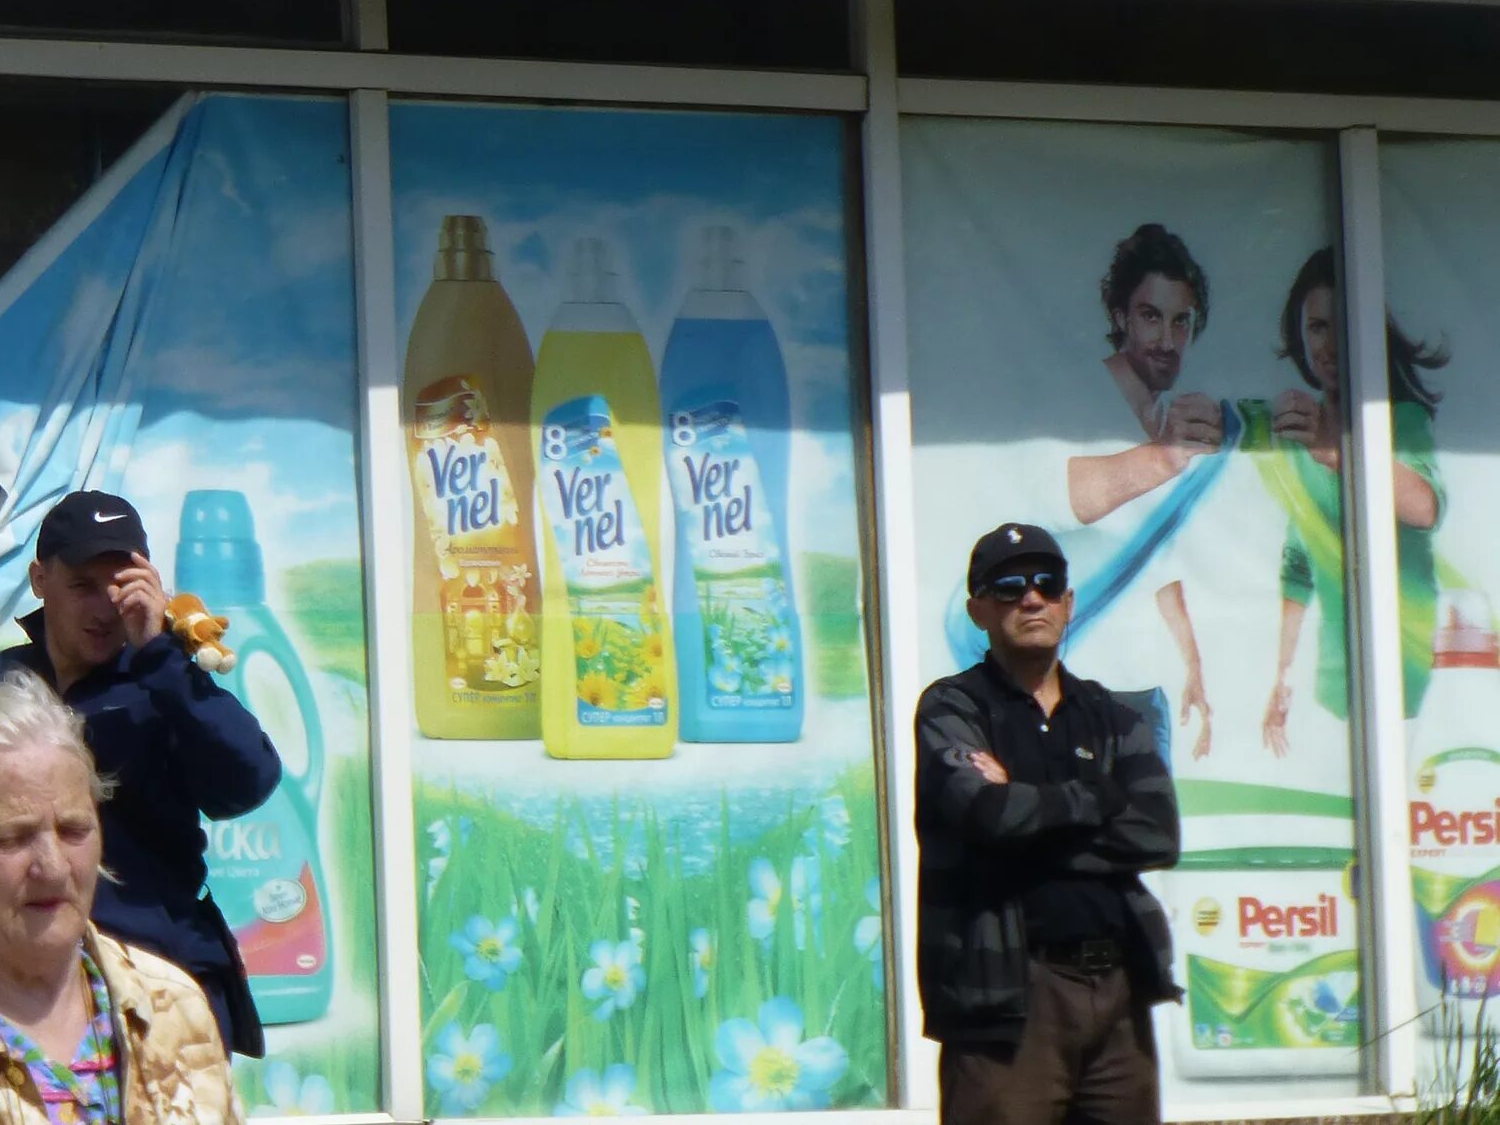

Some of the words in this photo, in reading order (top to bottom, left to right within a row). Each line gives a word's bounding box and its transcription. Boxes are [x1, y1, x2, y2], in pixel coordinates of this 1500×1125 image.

[427, 444, 487, 499] Ver
[554, 466, 612, 520] Ver
[684, 452, 740, 505] Ver
[447, 478, 499, 535] nel
[575, 500, 625, 556] nel
[704, 484, 753, 542] nel
[1238, 893, 1338, 938] Persil
